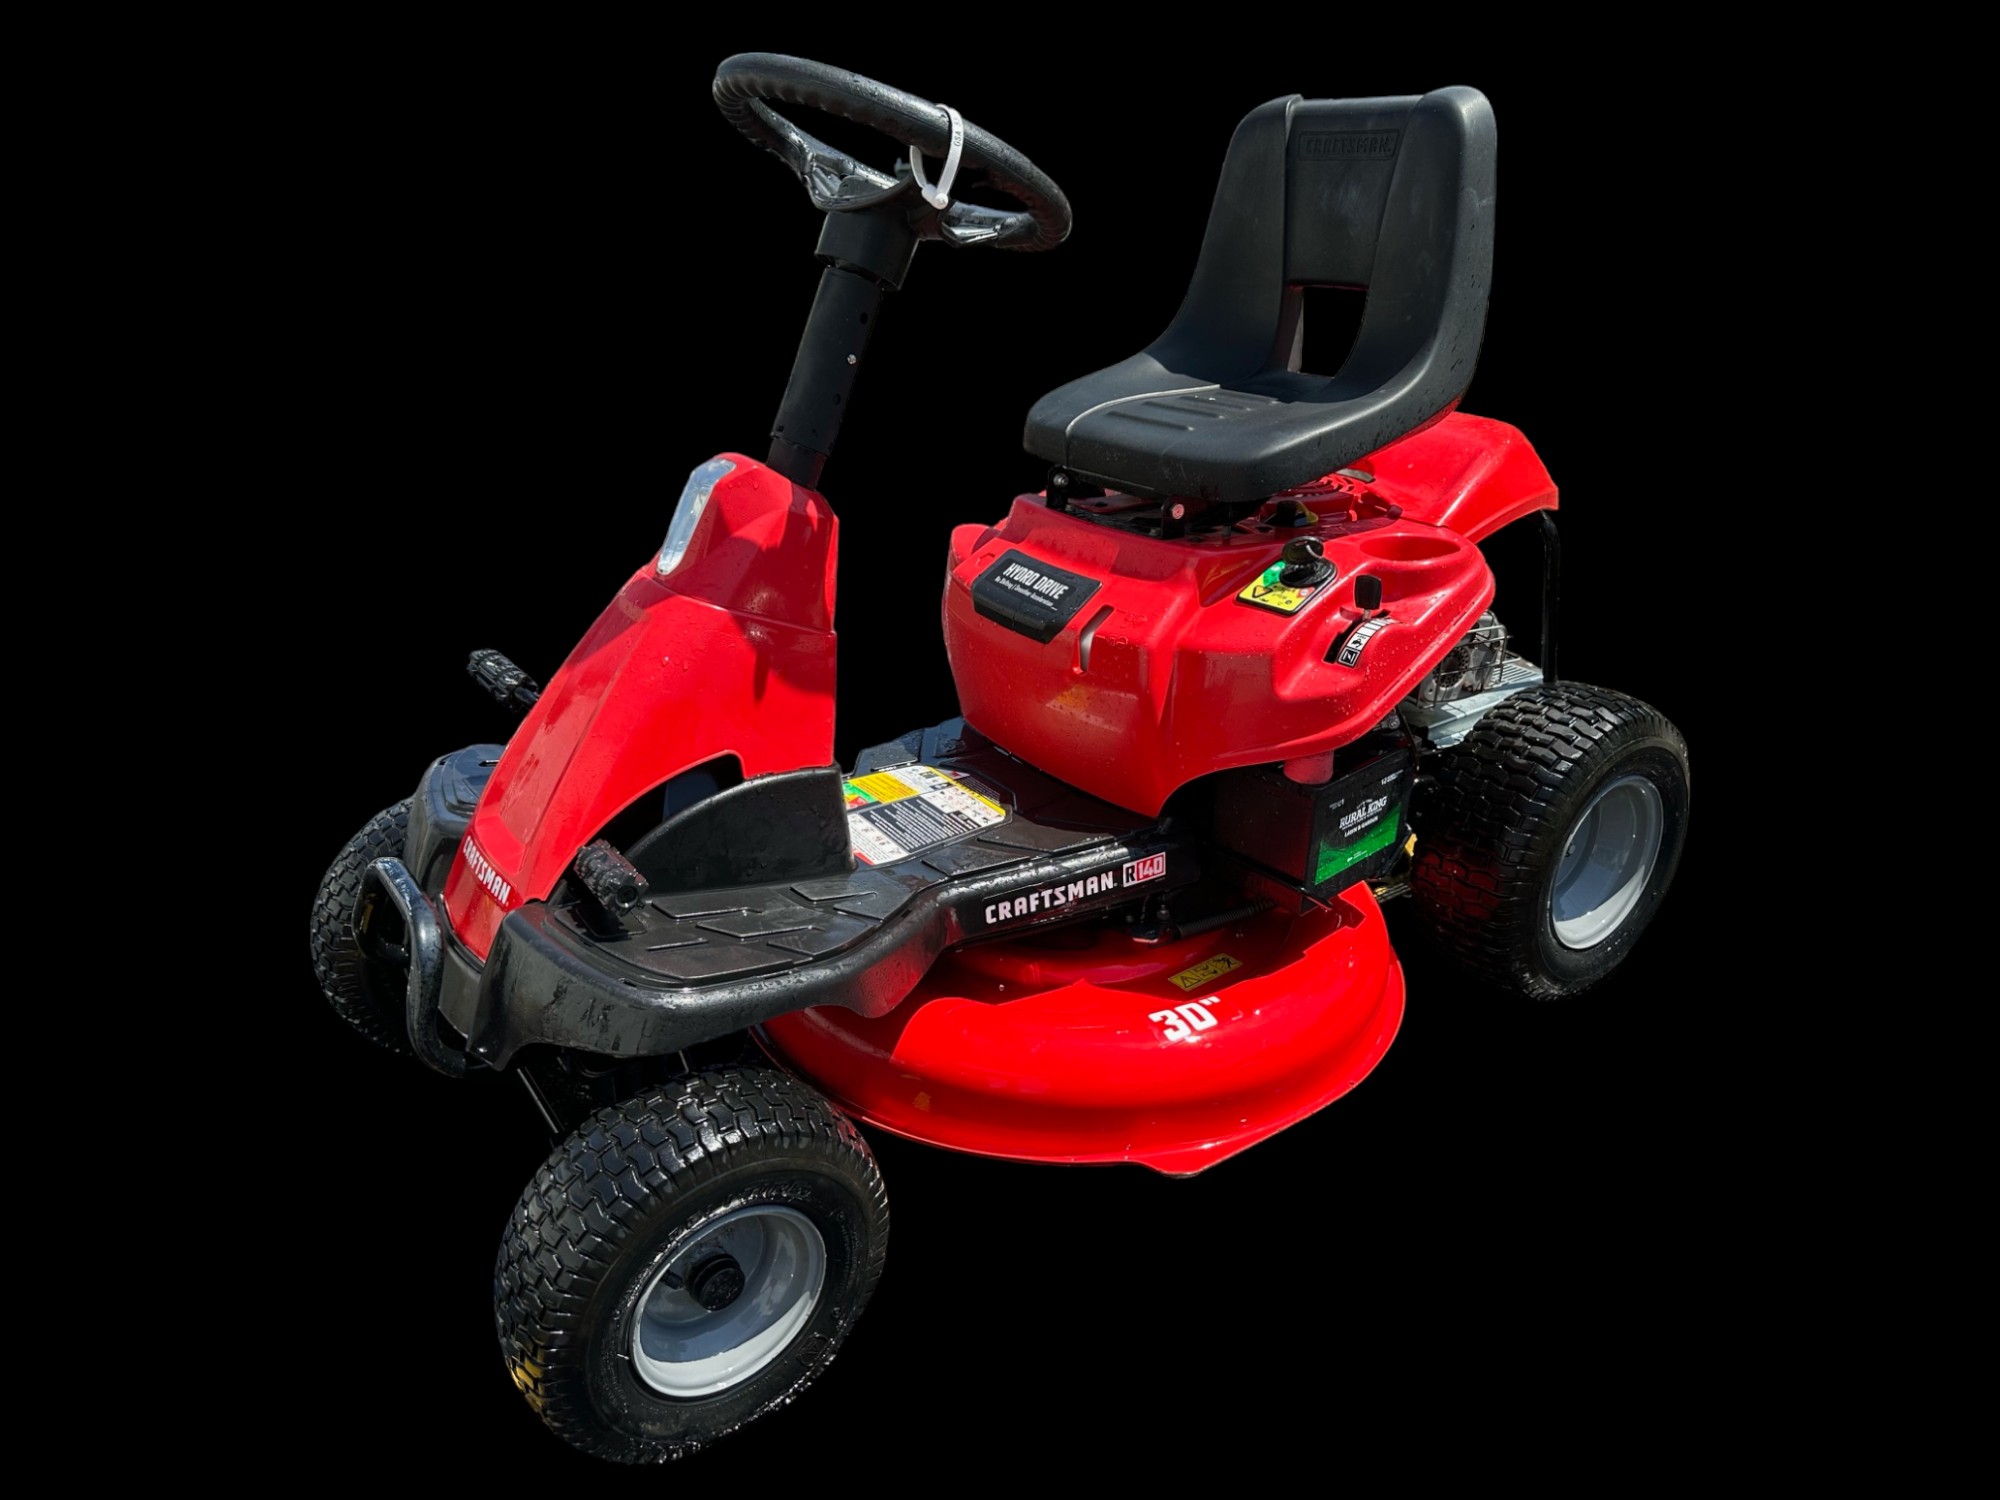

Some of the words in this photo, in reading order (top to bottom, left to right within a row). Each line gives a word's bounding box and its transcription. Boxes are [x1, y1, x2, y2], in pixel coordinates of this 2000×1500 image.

[1002, 562, 1041, 587] HYDRO
[1032, 576, 1069, 600] DRIVE
[1339, 808, 1367, 829] RURAL
[1367, 796, 1388, 815] KING
[463, 835, 511, 905] CRAFTSMAN
[985, 871, 1115, 924] CRAFTSMAN
[1125, 858, 1163, 885] R140
[1147, 995, 1221, 1042] 30"
